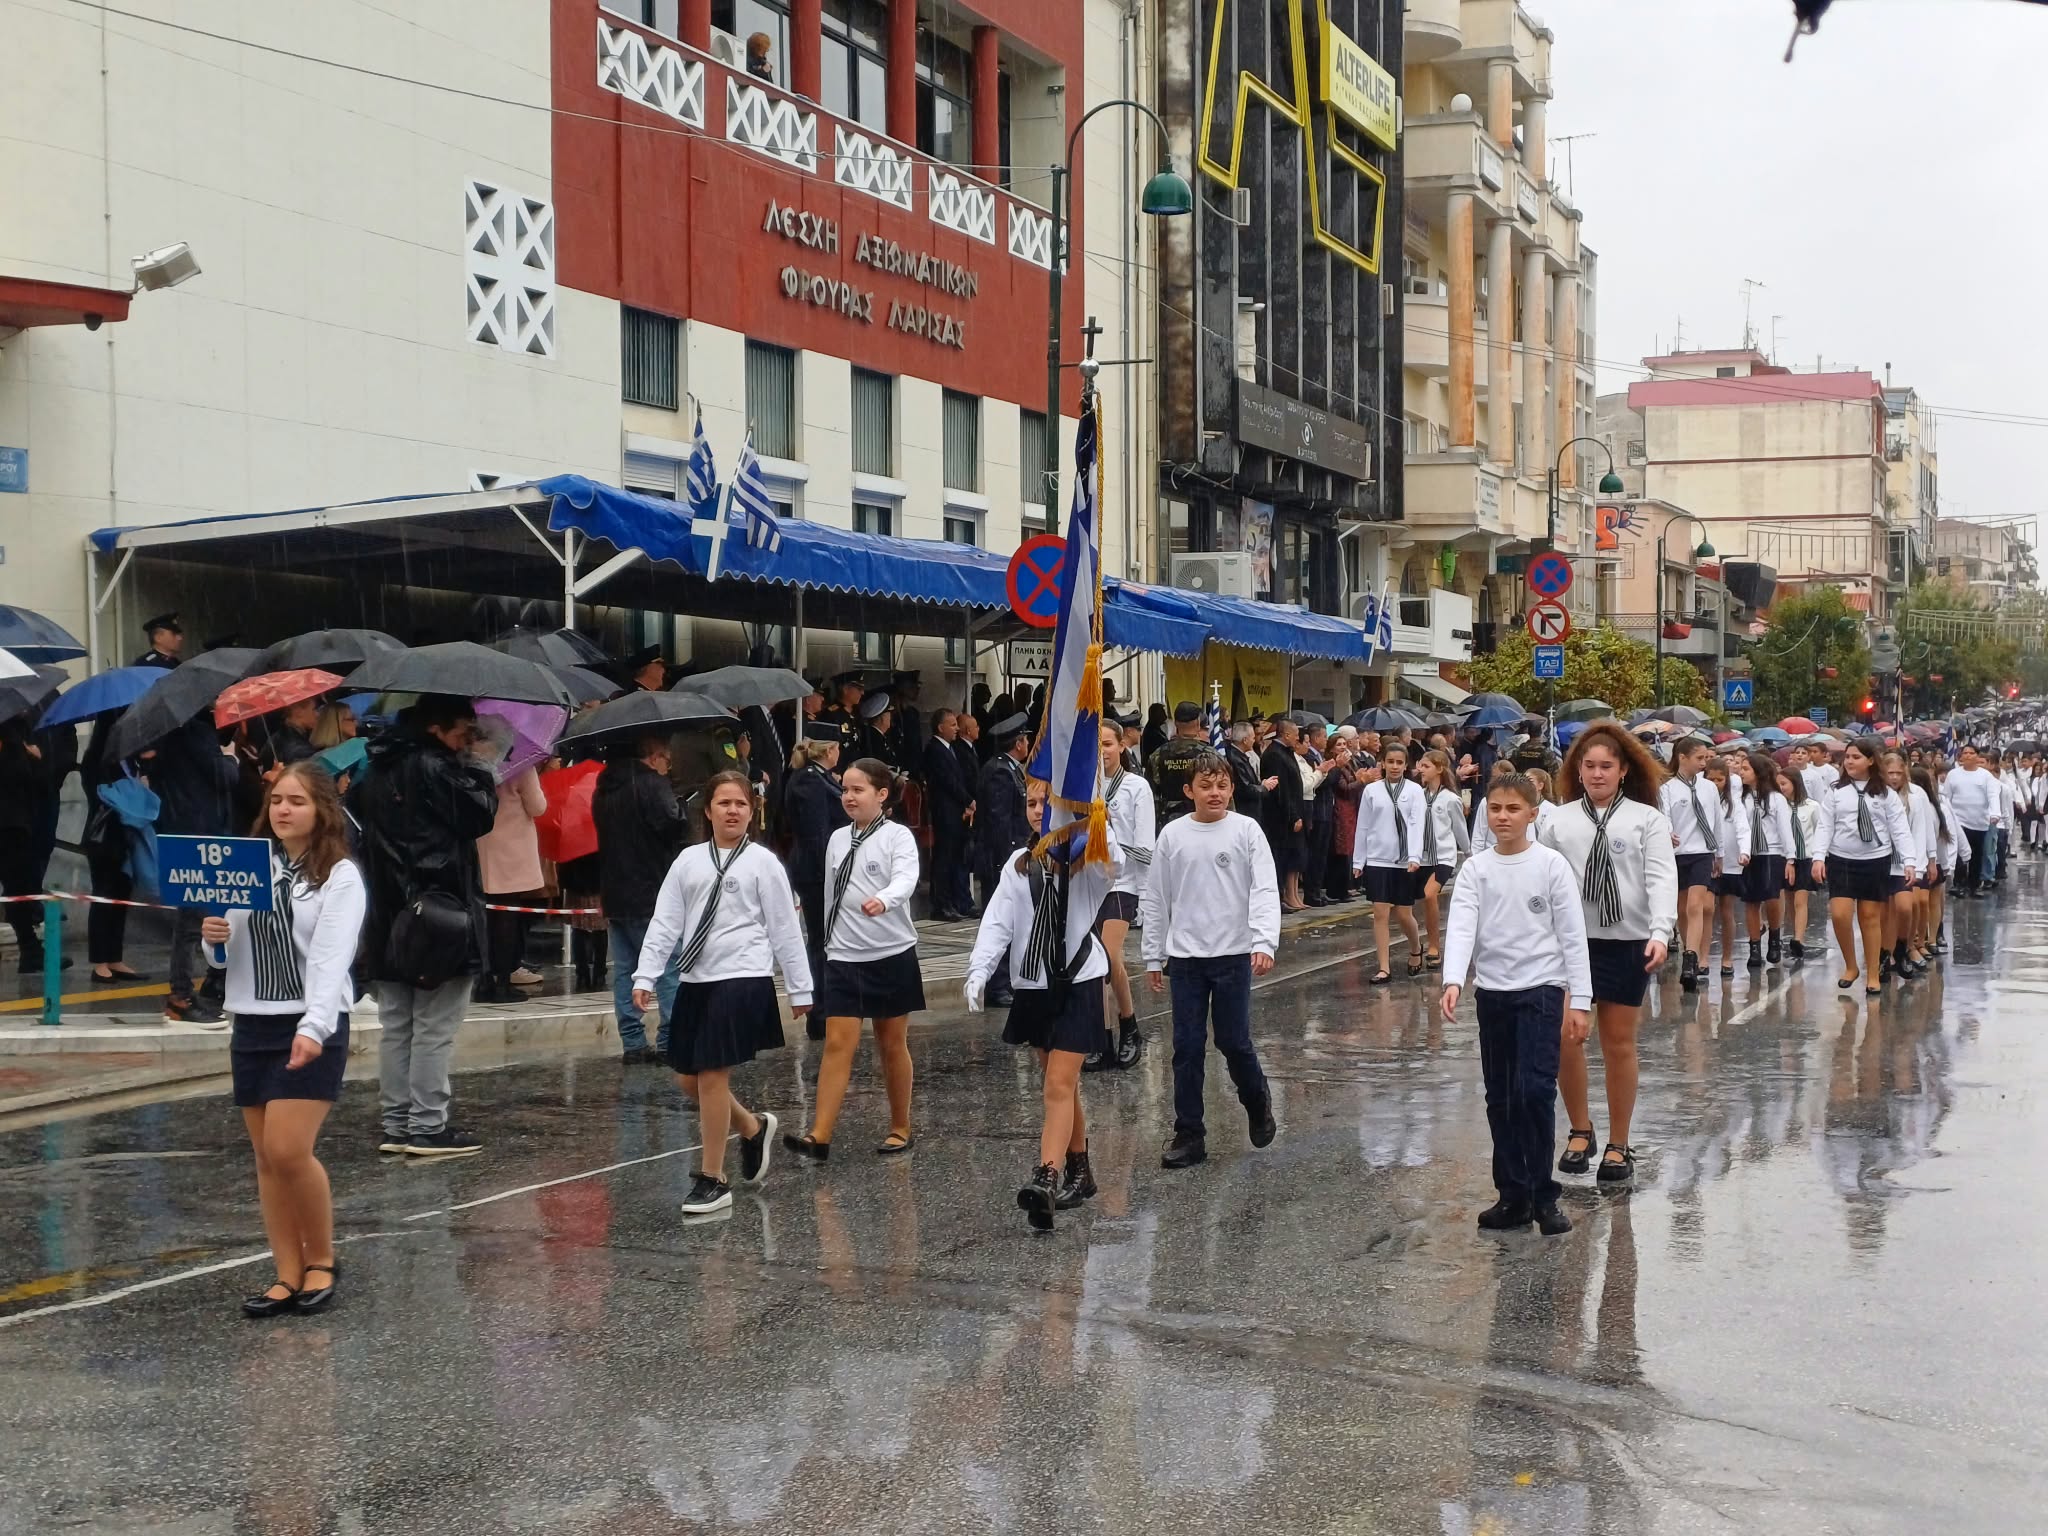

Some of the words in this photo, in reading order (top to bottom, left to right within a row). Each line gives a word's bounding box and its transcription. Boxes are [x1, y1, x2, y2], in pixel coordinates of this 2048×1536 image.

[1336, 43, 1390, 115] ALTERLIFE
[763, 198, 839, 255] ΛΕΣΧΗ
[854, 231, 978, 300] ΑΞΙΩΜΑΤΙΚΩΝ
[780, 265, 875, 325] ΦΡΟΥΡΑΣ
[887, 297, 965, 350] ΛΑΡΙΣΑΣ
[1015, 647, 1035, 655] ΠΛΗΝ
[168, 868, 209, 885] ΔΗΜ.
[215, 870, 264, 888] ΣΧΟΛ.
[182, 887, 252, 905] ΛΑΡΙΣΑΣ
